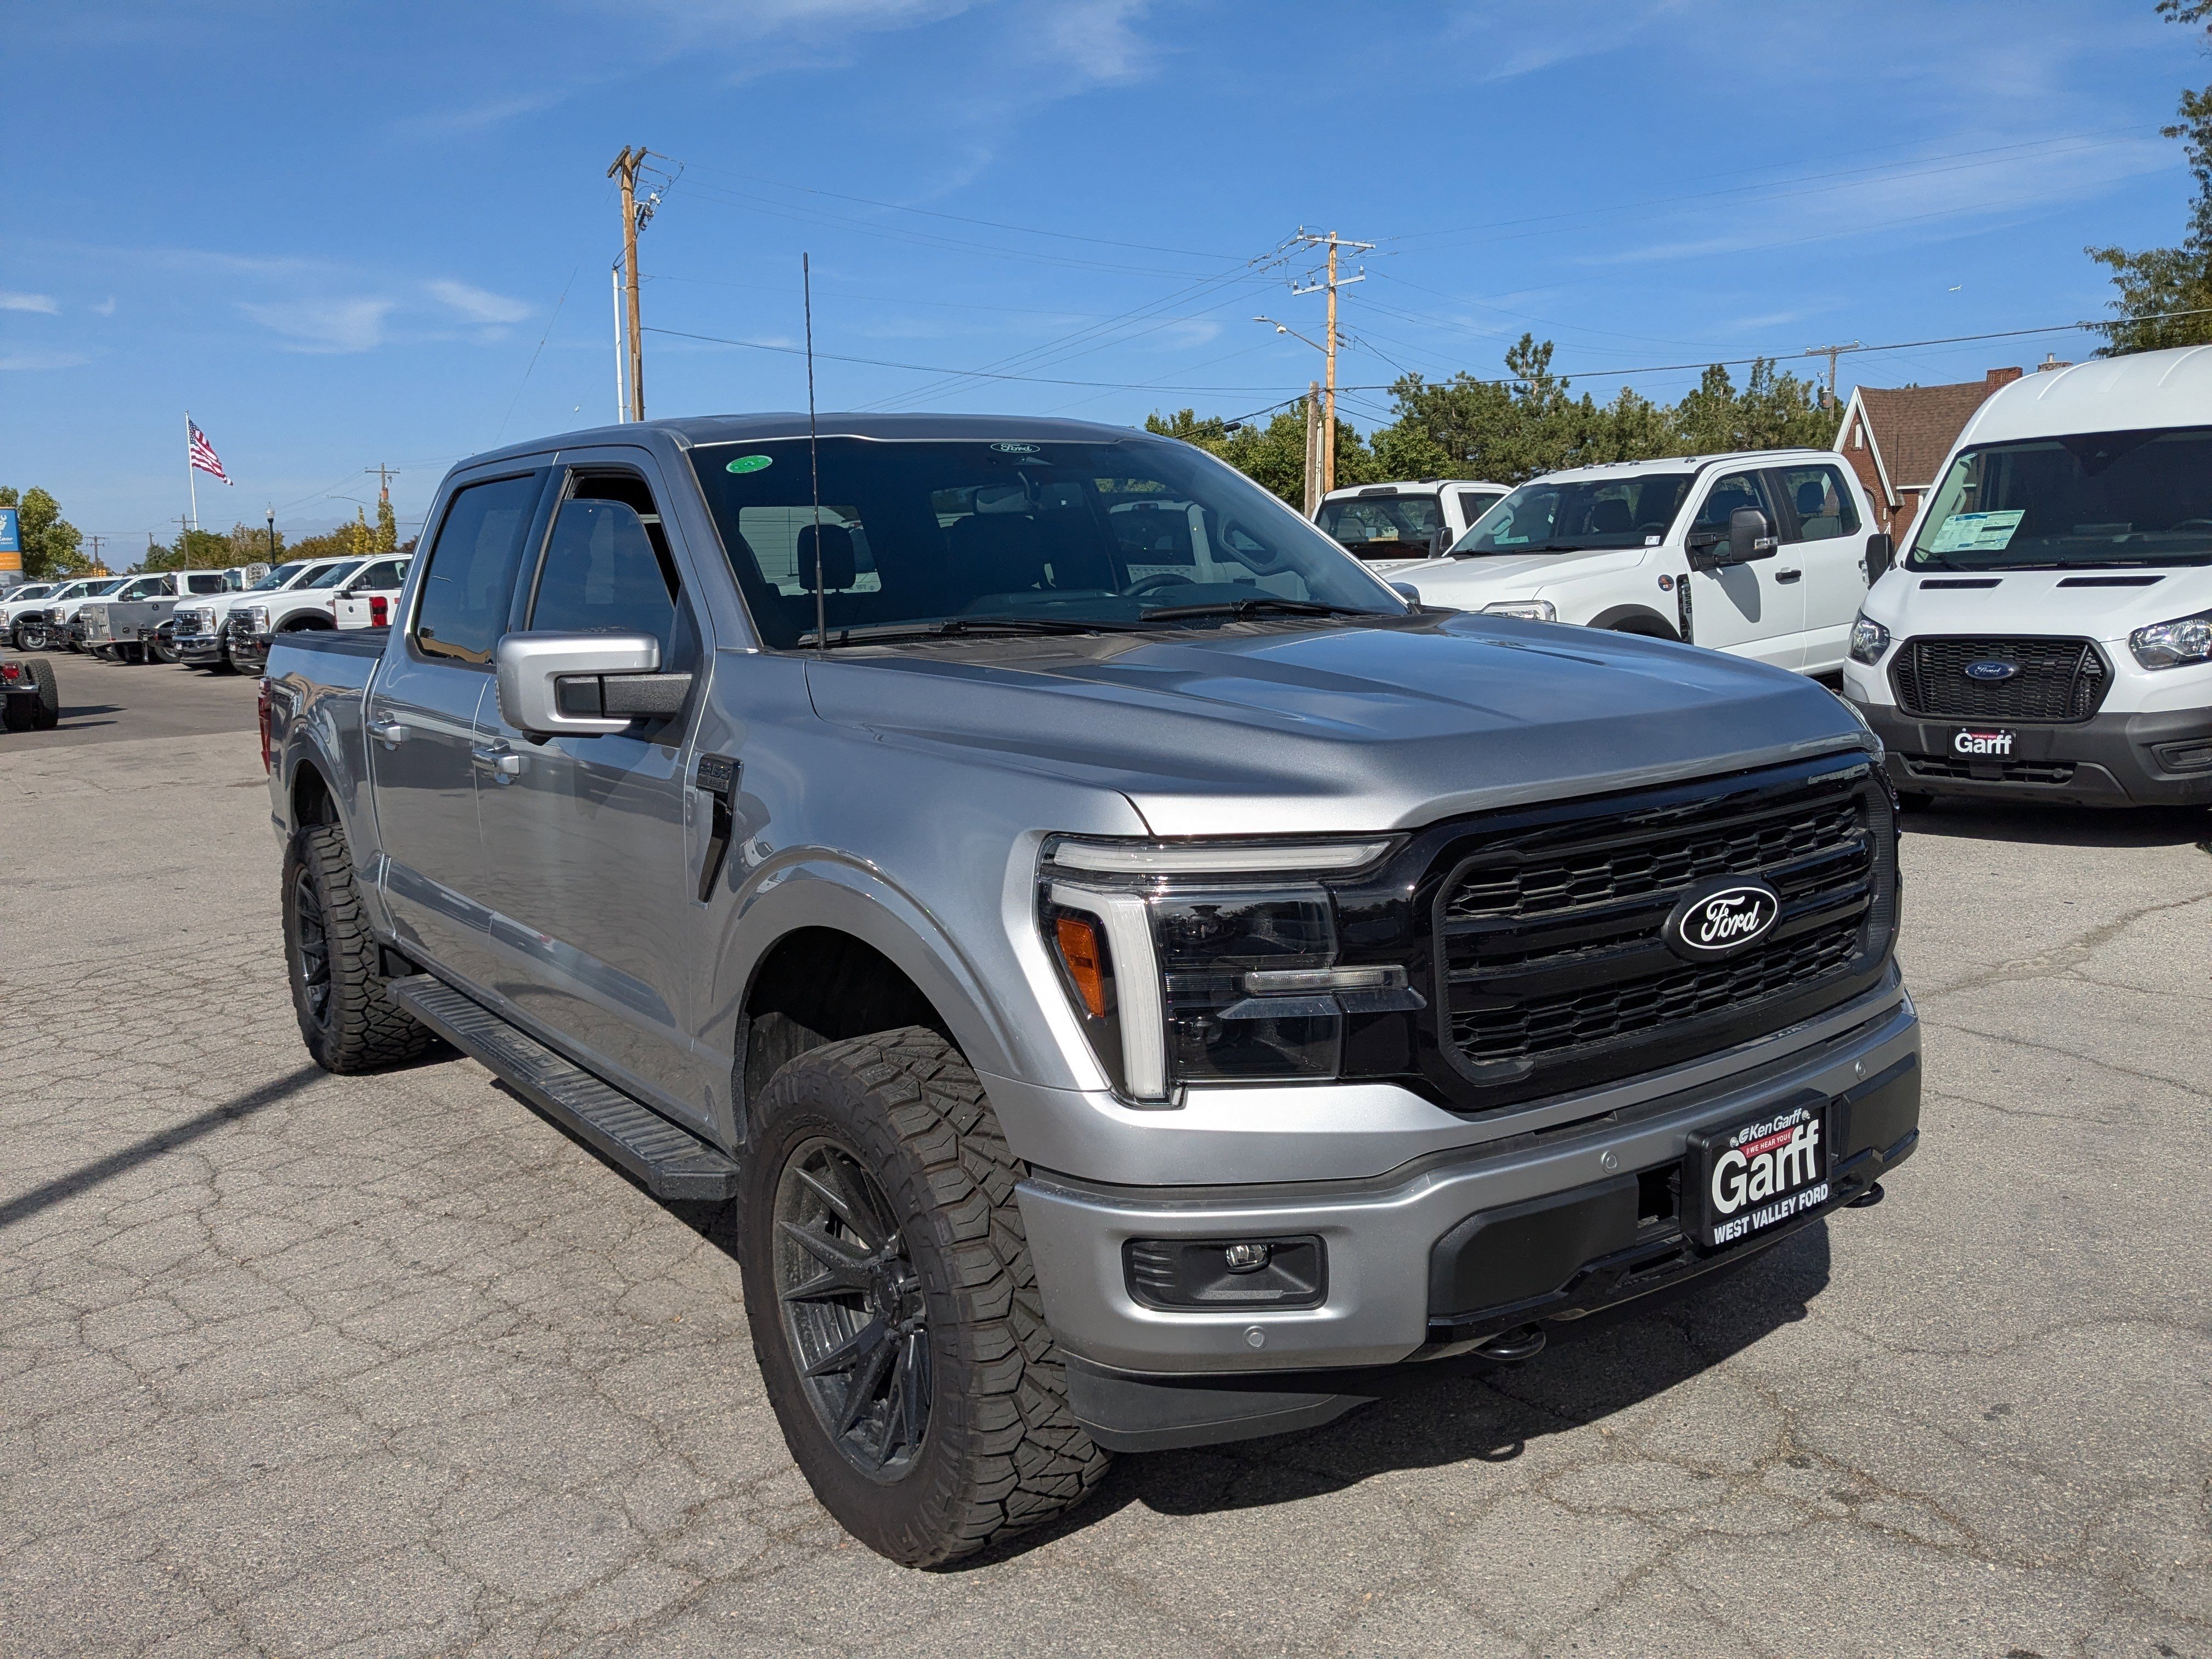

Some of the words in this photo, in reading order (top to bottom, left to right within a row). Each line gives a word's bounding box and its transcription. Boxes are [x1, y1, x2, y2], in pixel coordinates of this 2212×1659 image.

[1001, 443, 1032, 452] Ford
[1955, 732, 2012, 754] Garff
[1701, 895, 1760, 942] Ford
[1749, 1123, 1773, 1141] Ken
[1773, 1108, 1802, 1132] Garff
[1750, 1144, 1759, 1153] WE
[1760, 1138, 1776, 1149] HEAR
[1776, 1133, 1787, 1143] YOU
[1712, 1119, 1819, 1214] Garff
[1714, 1216, 1750, 1245] WEST
[1752, 1197, 1797, 1229] VALLEY
[1799, 1183, 1829, 1211] FORD
